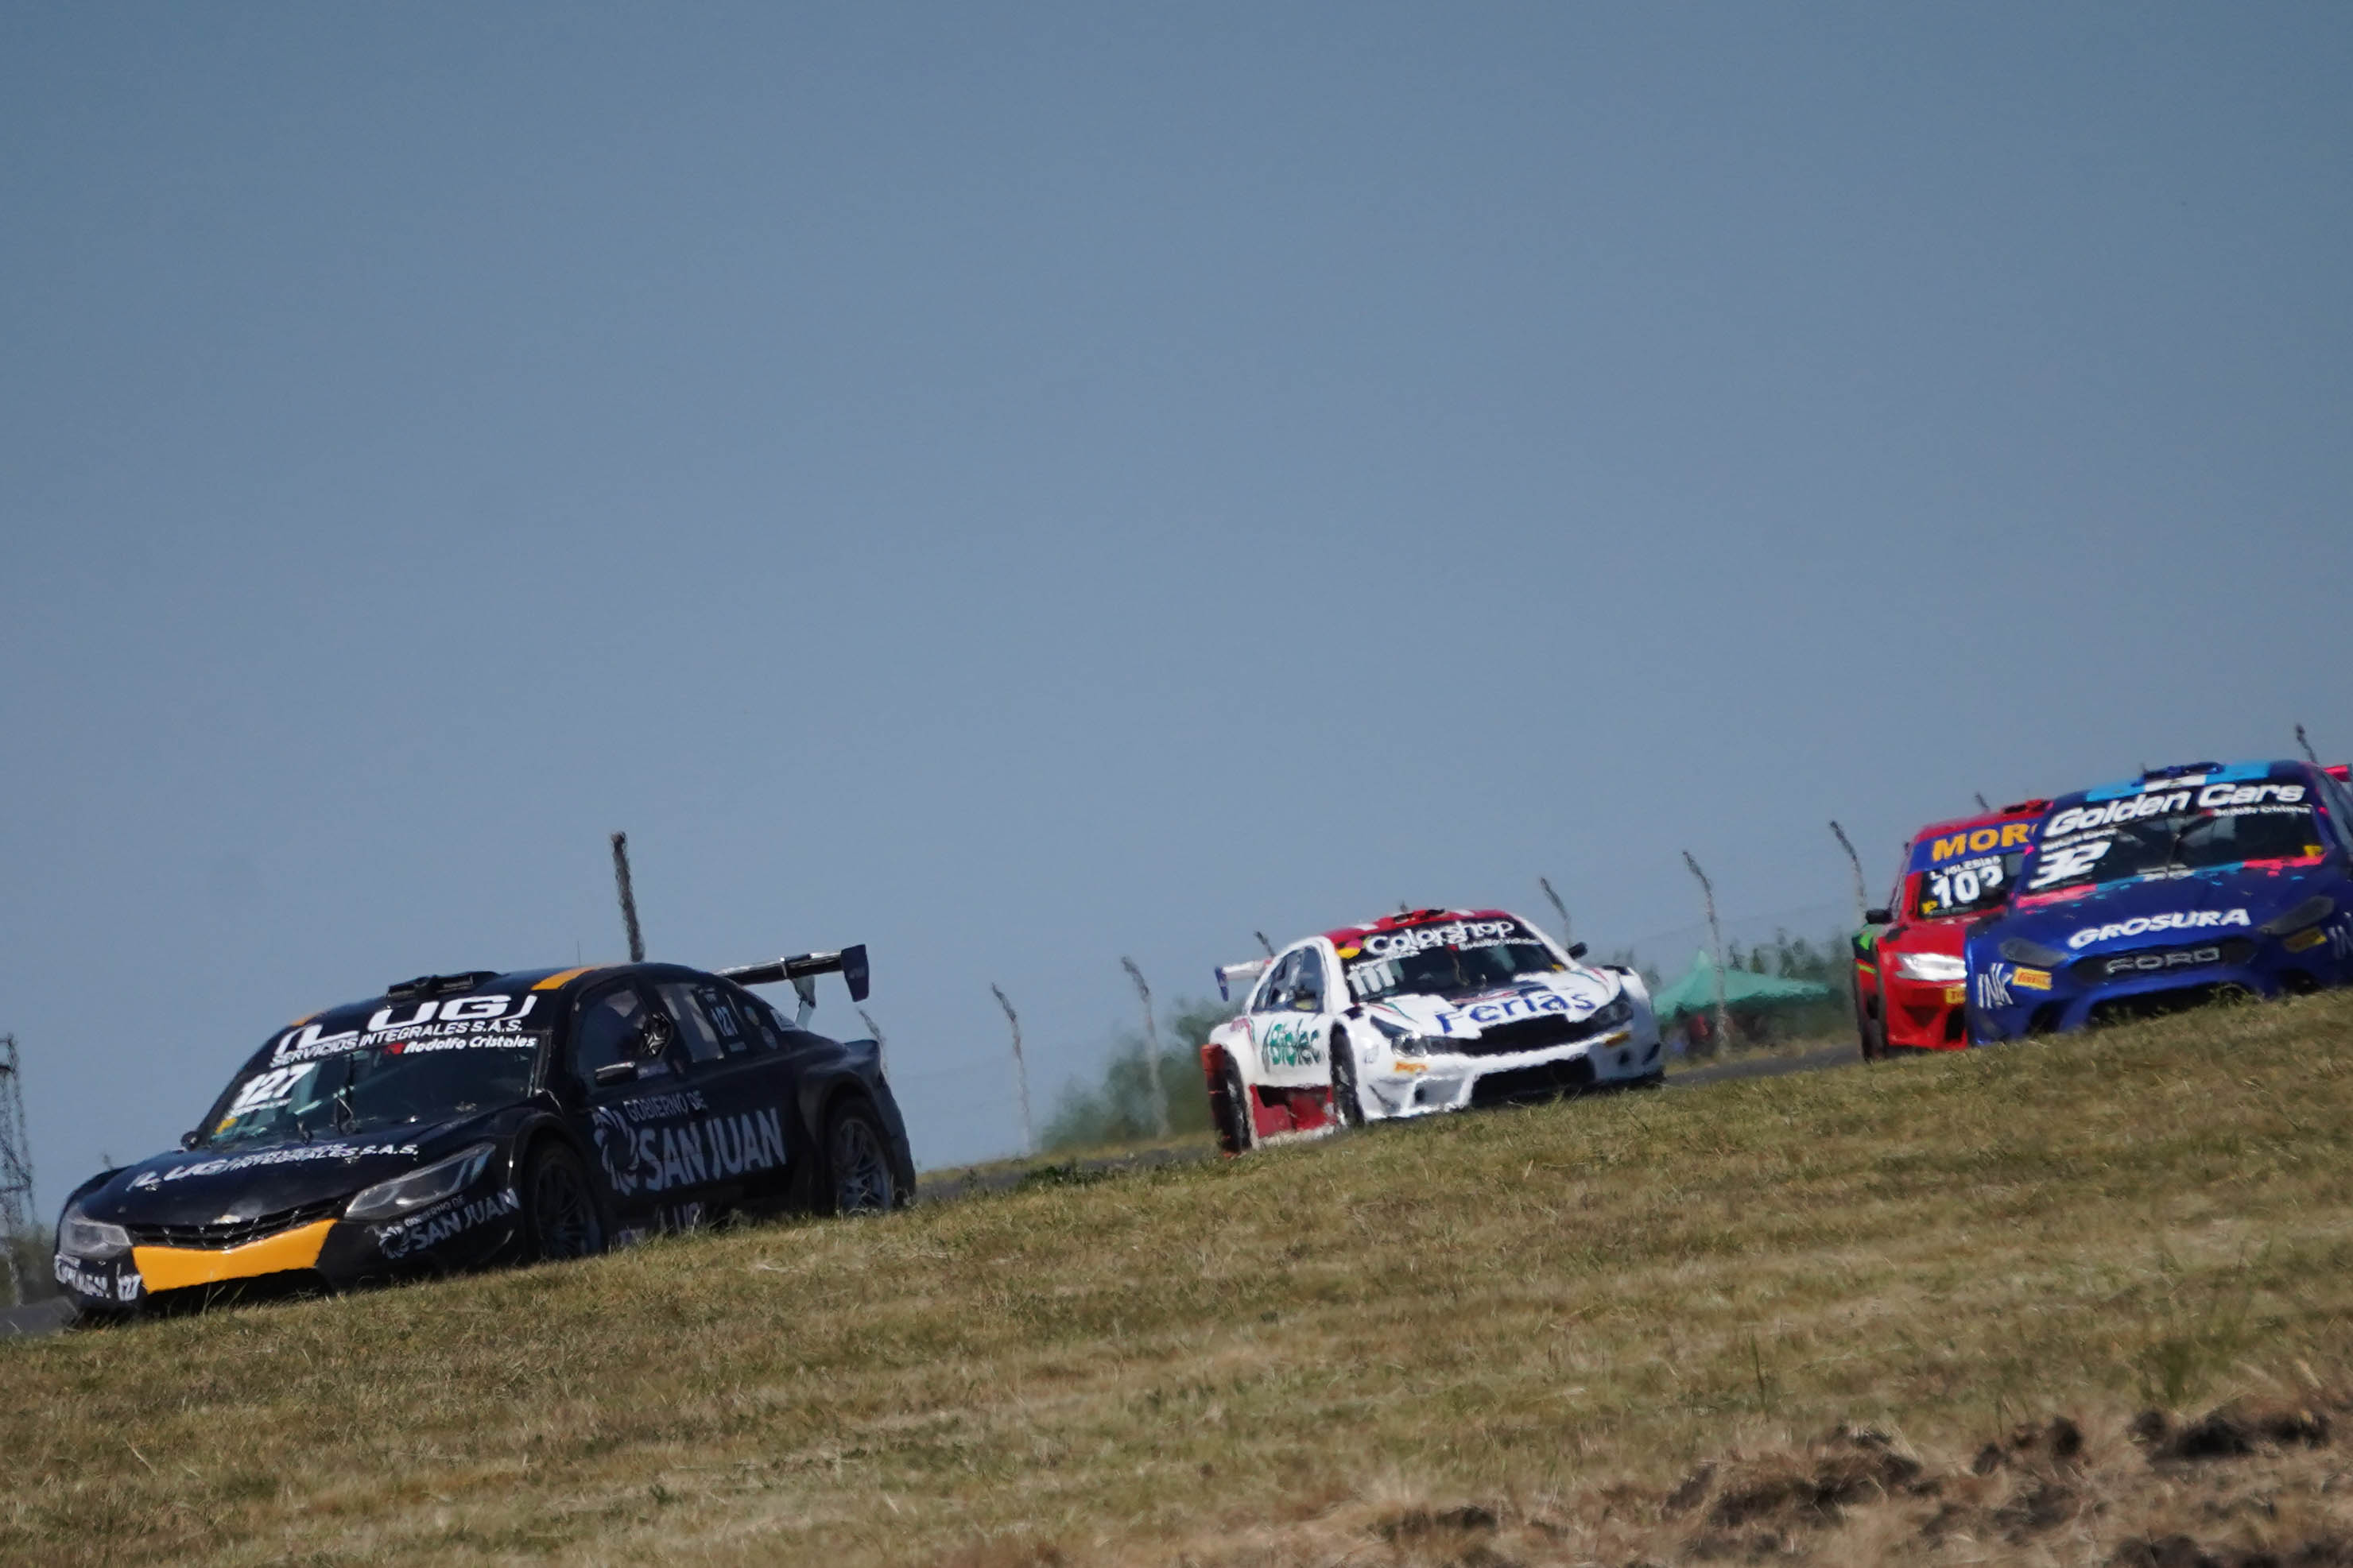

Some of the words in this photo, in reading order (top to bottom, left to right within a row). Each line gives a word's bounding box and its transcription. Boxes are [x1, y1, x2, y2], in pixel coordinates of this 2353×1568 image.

[2045, 789, 2192, 837] Golden
[2197, 783, 2305, 810] Cars
[1932, 823, 2038, 861] MOR
[1364, 920, 1514, 955] Colorshop
[2068, 908, 2251, 950] GROSURA
[2106, 947, 2219, 975] FORD
[358, 1021, 471, 1048] INTEGRALES
[471, 1019, 523, 1033] S.A.S.
[403, 1036, 467, 1055] Rodolfo
[469, 1033, 537, 1048] Cristales
[639, 1121, 708, 1191] SAN
[705, 1107, 787, 1180] JUAN
[409, 1211, 462, 1250] SAN
[463, 1187, 521, 1229] JUAN
